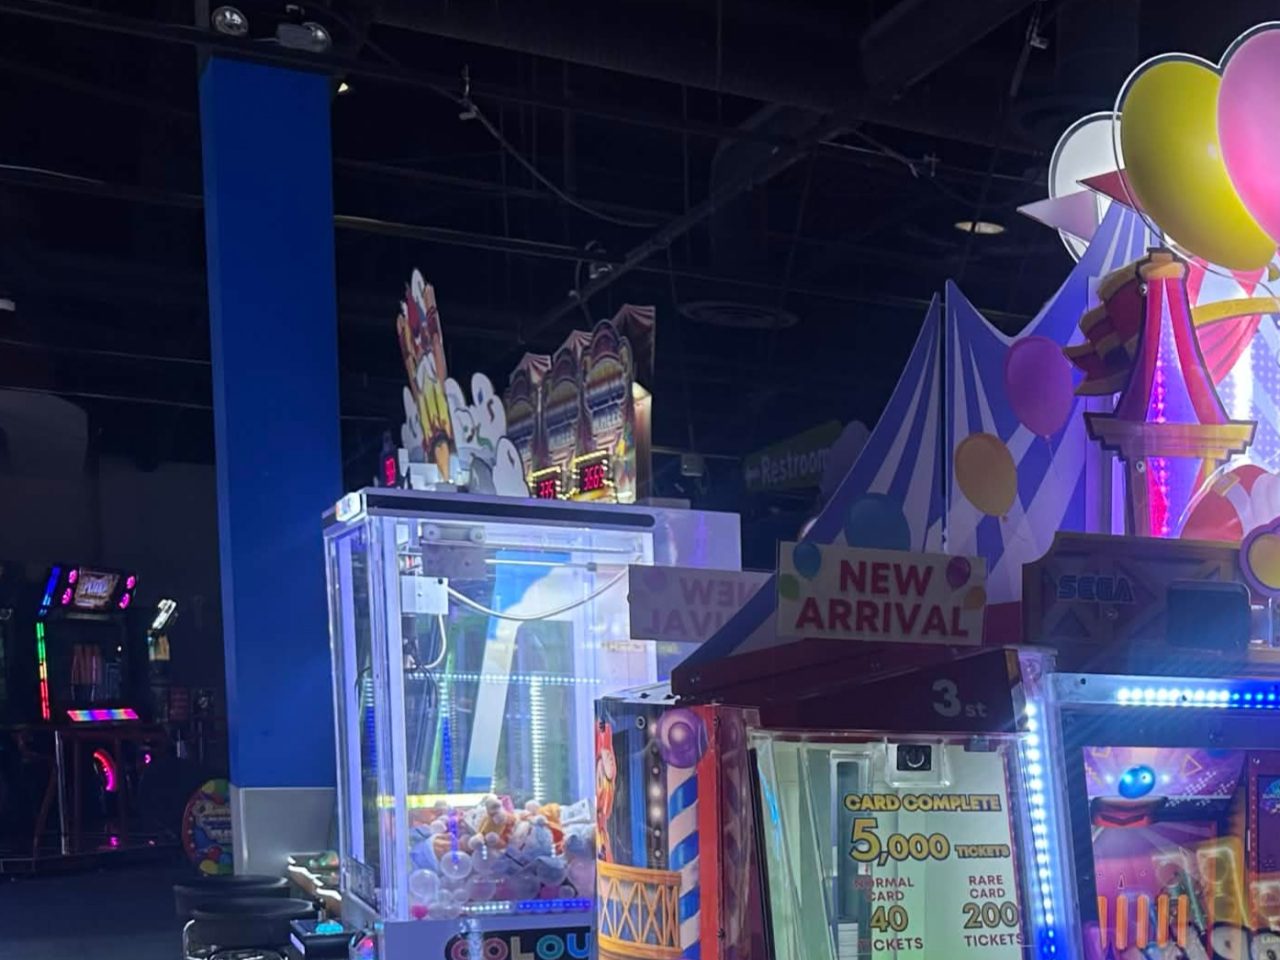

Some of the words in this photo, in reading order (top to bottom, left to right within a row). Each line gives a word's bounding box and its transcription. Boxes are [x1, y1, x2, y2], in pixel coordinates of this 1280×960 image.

[840, 559, 933, 597] NEW
[1058, 574, 1134, 602] SEGA
[795, 597, 969, 637] ARRIVAL
[932, 679, 961, 717] 3
[965, 701, 987, 718] st
[845, 794, 900, 812] CARD
[901, 794, 1002, 812] COMPLETE
[850, 817, 951, 866] 5,000
[955, 844, 1011, 860] TICKETS
[854, 876, 915, 889] NORMAL
[968, 875, 1004, 886] RARE
[969, 887, 1006, 899] CARD
[869, 890, 905, 902] CARD
[870, 905, 909, 932] 40
[962, 902, 1020, 928] 200
[964, 932, 1025, 948] TICKETS
